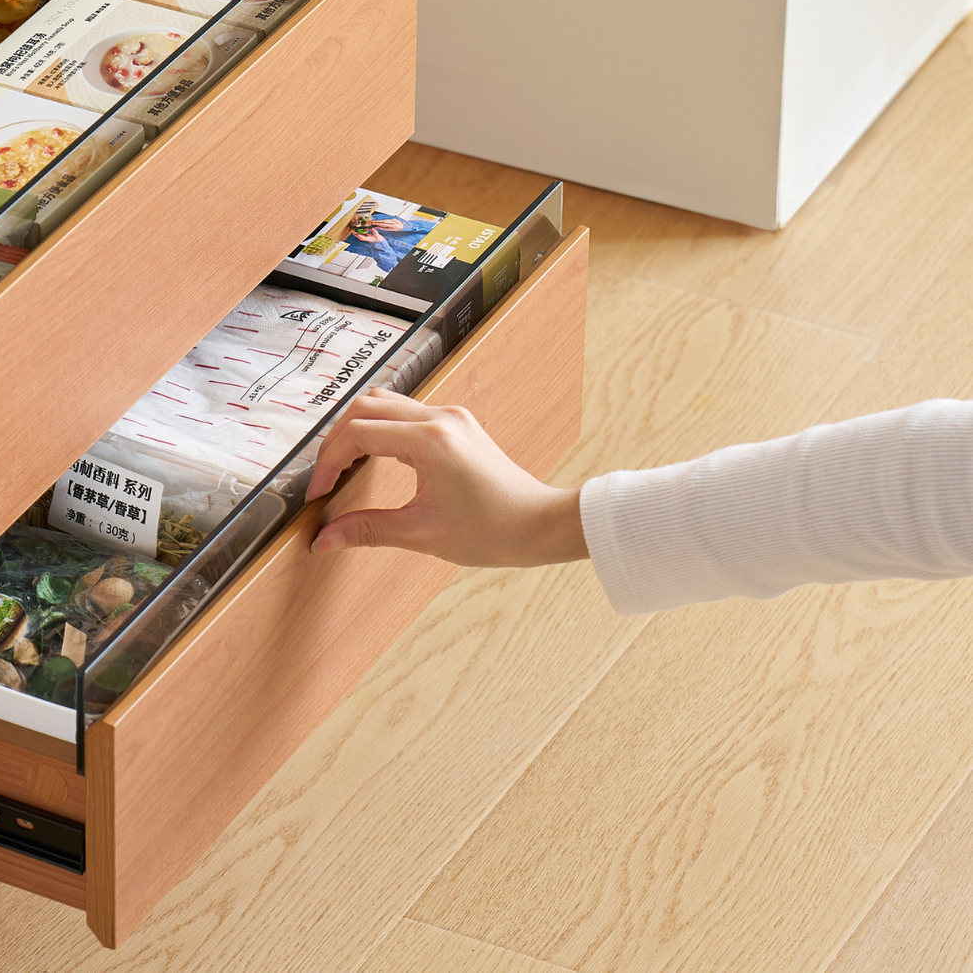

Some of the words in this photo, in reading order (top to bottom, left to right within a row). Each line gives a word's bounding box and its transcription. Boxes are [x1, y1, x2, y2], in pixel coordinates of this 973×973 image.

[25, 40, 50, 58] Wolfberry
[43, 26, 65, 41] Tremella
[59, 17, 76, 27] Soup
[147, 79, 195, 116] 其他方便食品
[468, 228, 496, 249] ISTAD
[320, 331, 337, 348] Emma
[365, 339, 376, 349] x
[373, 330, 392, 343] 30
[302, 348, 324, 372] Hagman
[307, 347, 373, 406] SNÖKRABBA
[123, 477, 153, 502] 系列
[67, 479, 147, 525] 【香茅草/香草】
